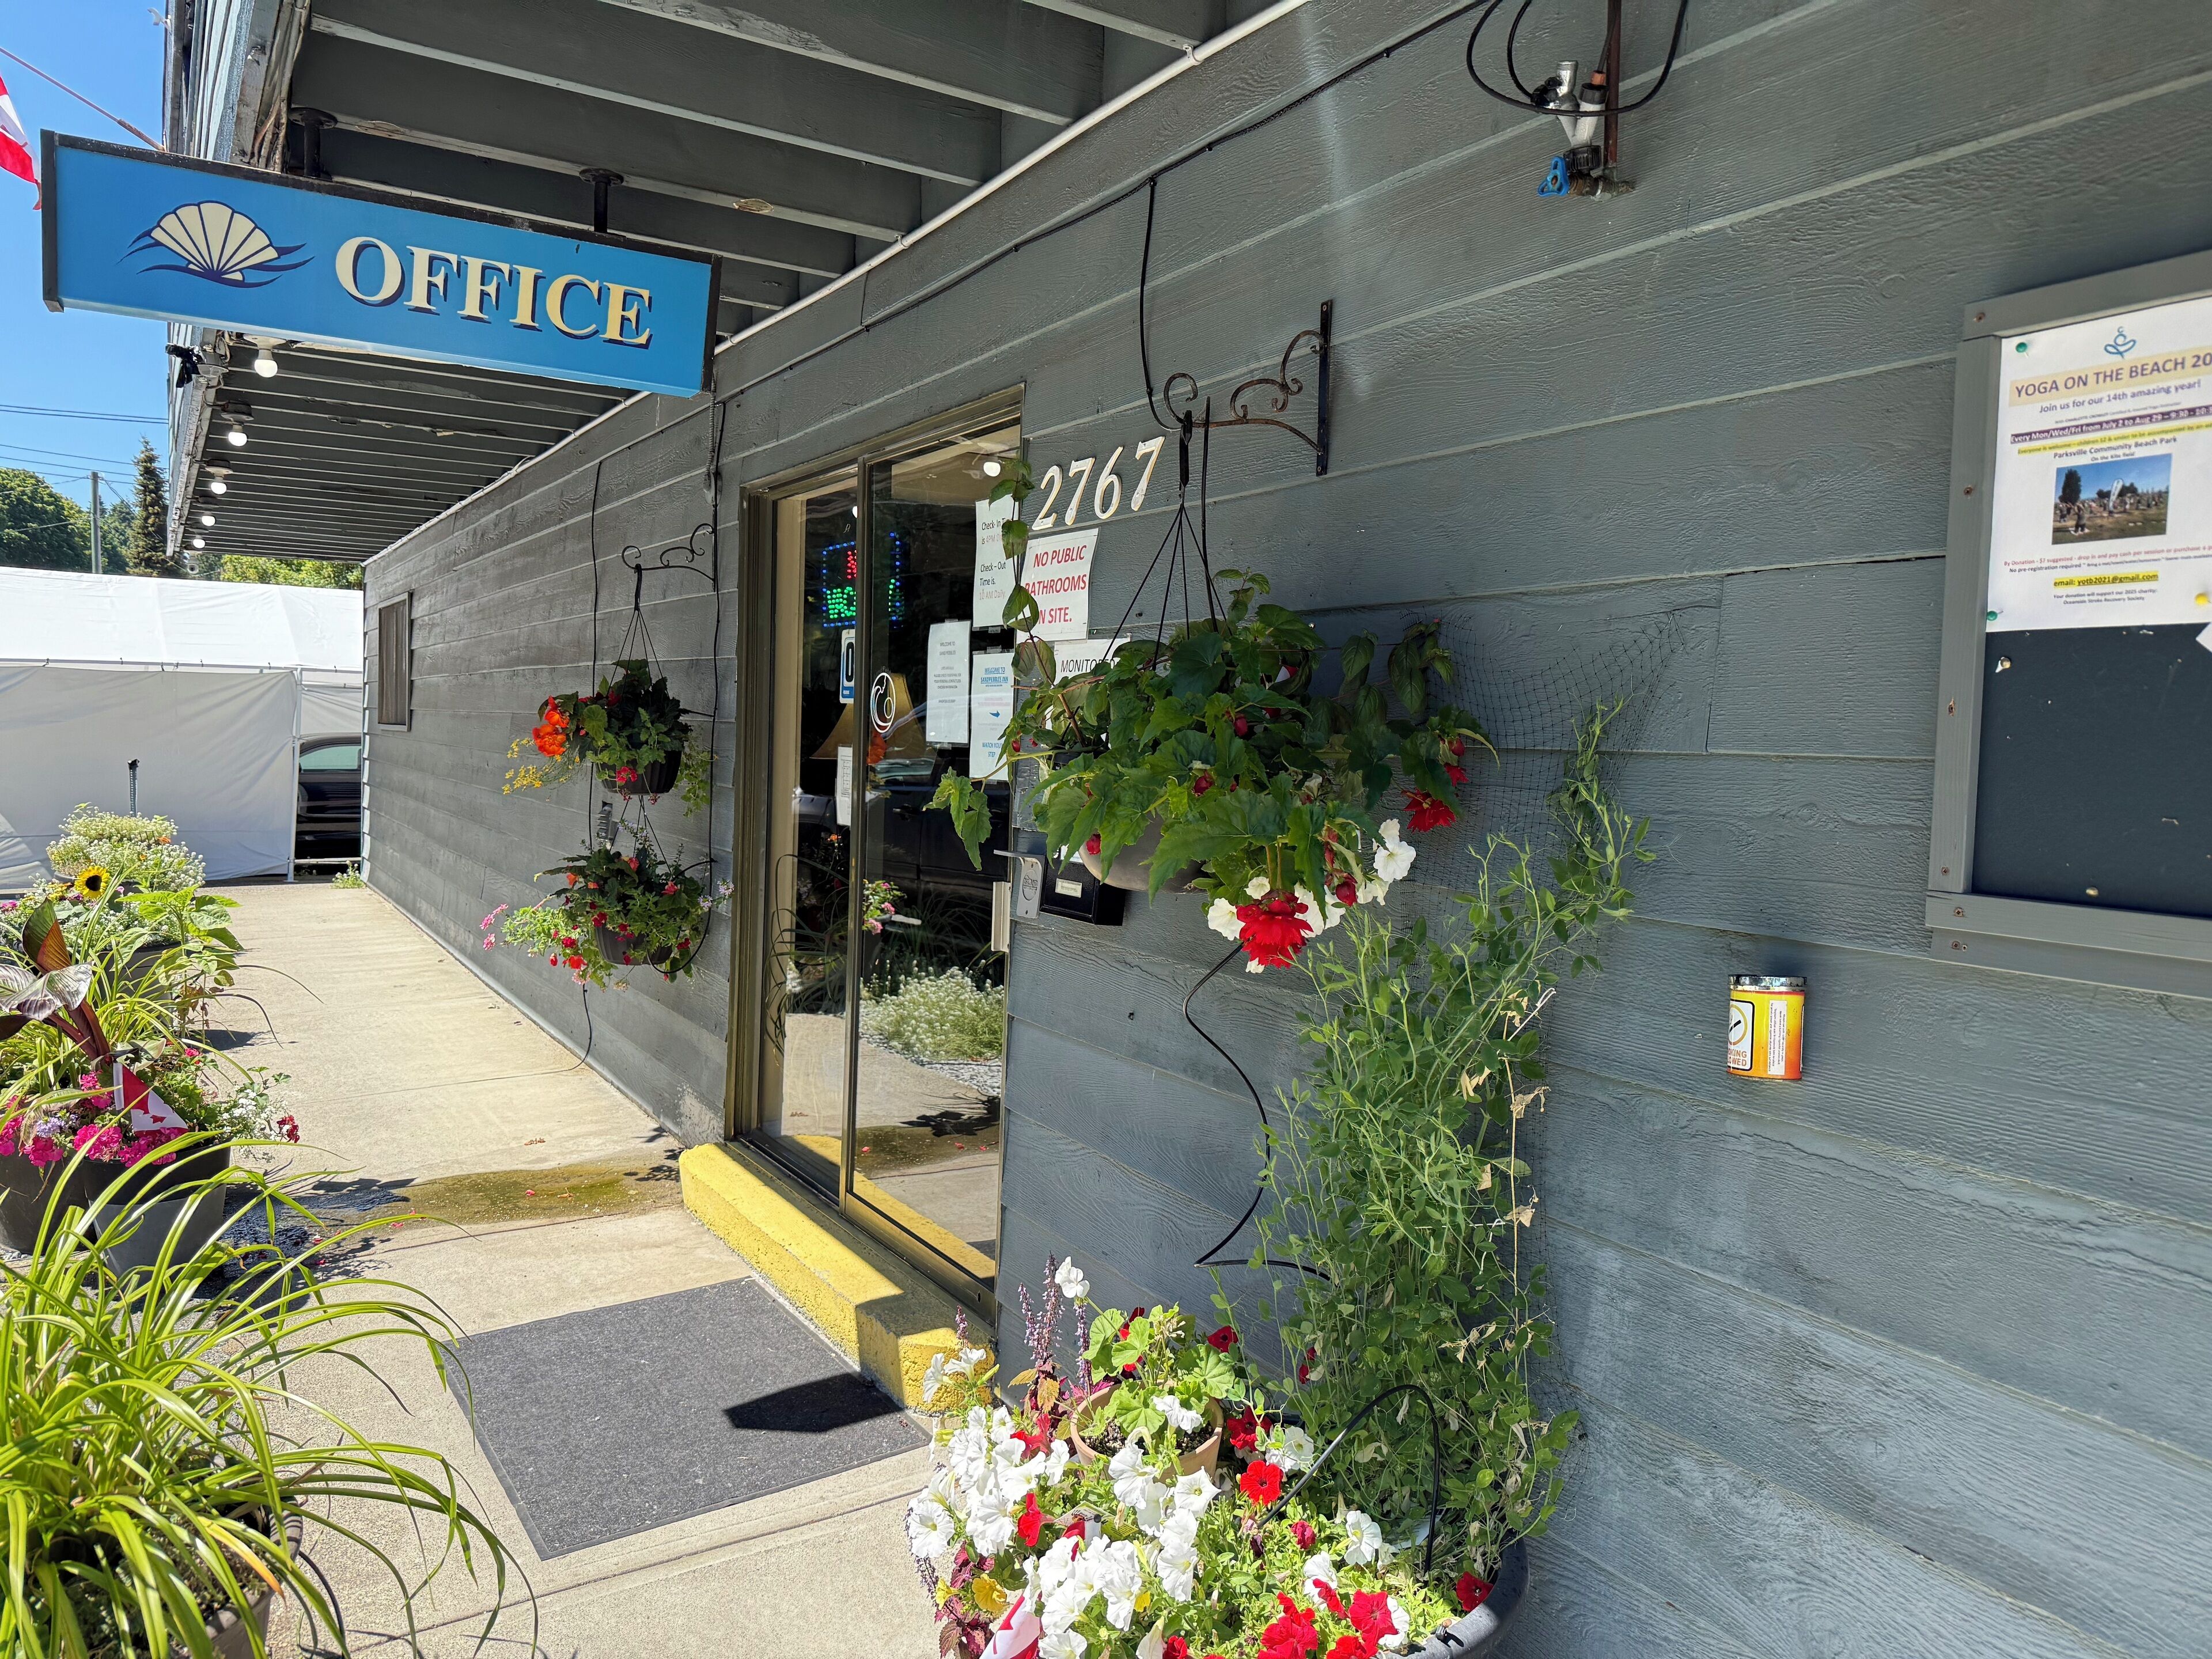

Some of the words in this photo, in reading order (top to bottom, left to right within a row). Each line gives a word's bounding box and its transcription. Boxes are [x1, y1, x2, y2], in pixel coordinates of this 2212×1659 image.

[335, 236, 653, 349] OFFICE
[2015, 380, 2059, 398] YOGA
[2064, 374, 2089, 390] ON
[2093, 367, 2124, 384] THE
[2129, 357, 2186, 378] BEACH
[2039, 403, 2057, 413] Join
[2073, 399, 2085, 408] for
[2088, 397, 2103, 406] our
[2107, 392, 2127, 402] 14th
[2130, 385, 2172, 398] amazing
[2174, 379, 2201, 393] year!
[2010, 434, 2031, 443] Every
[2031, 426, 2081, 439] Mon/Wed/Fri
[2102, 420, 2117, 429] July
[2134, 416, 2151, 425] Aug
[2054, 448, 2087, 459] Parksville
[2089, 442, 2132, 454] Community
[2134, 438, 2157, 448] Beach
[2160, 435, 2177, 445] Park
[1032, 436, 1165, 531] 2767
[980, 562, 994, 573] Check
[997, 561, 1006, 570] Out
[1033, 551, 1049, 568] NO
[1050, 545, 1087, 565] PUBLIC
[2017, 565, 2058, 573] pre-registration
[2054, 578, 2075, 586] email:
[2077, 574, 2158, 586] yotb2021@gmail.com
[980, 577, 991, 586] Time
[1039, 609, 1046, 625] N
[1048, 607, 1072, 624] SITE.
[1060, 658, 1115, 673] MONITOD
